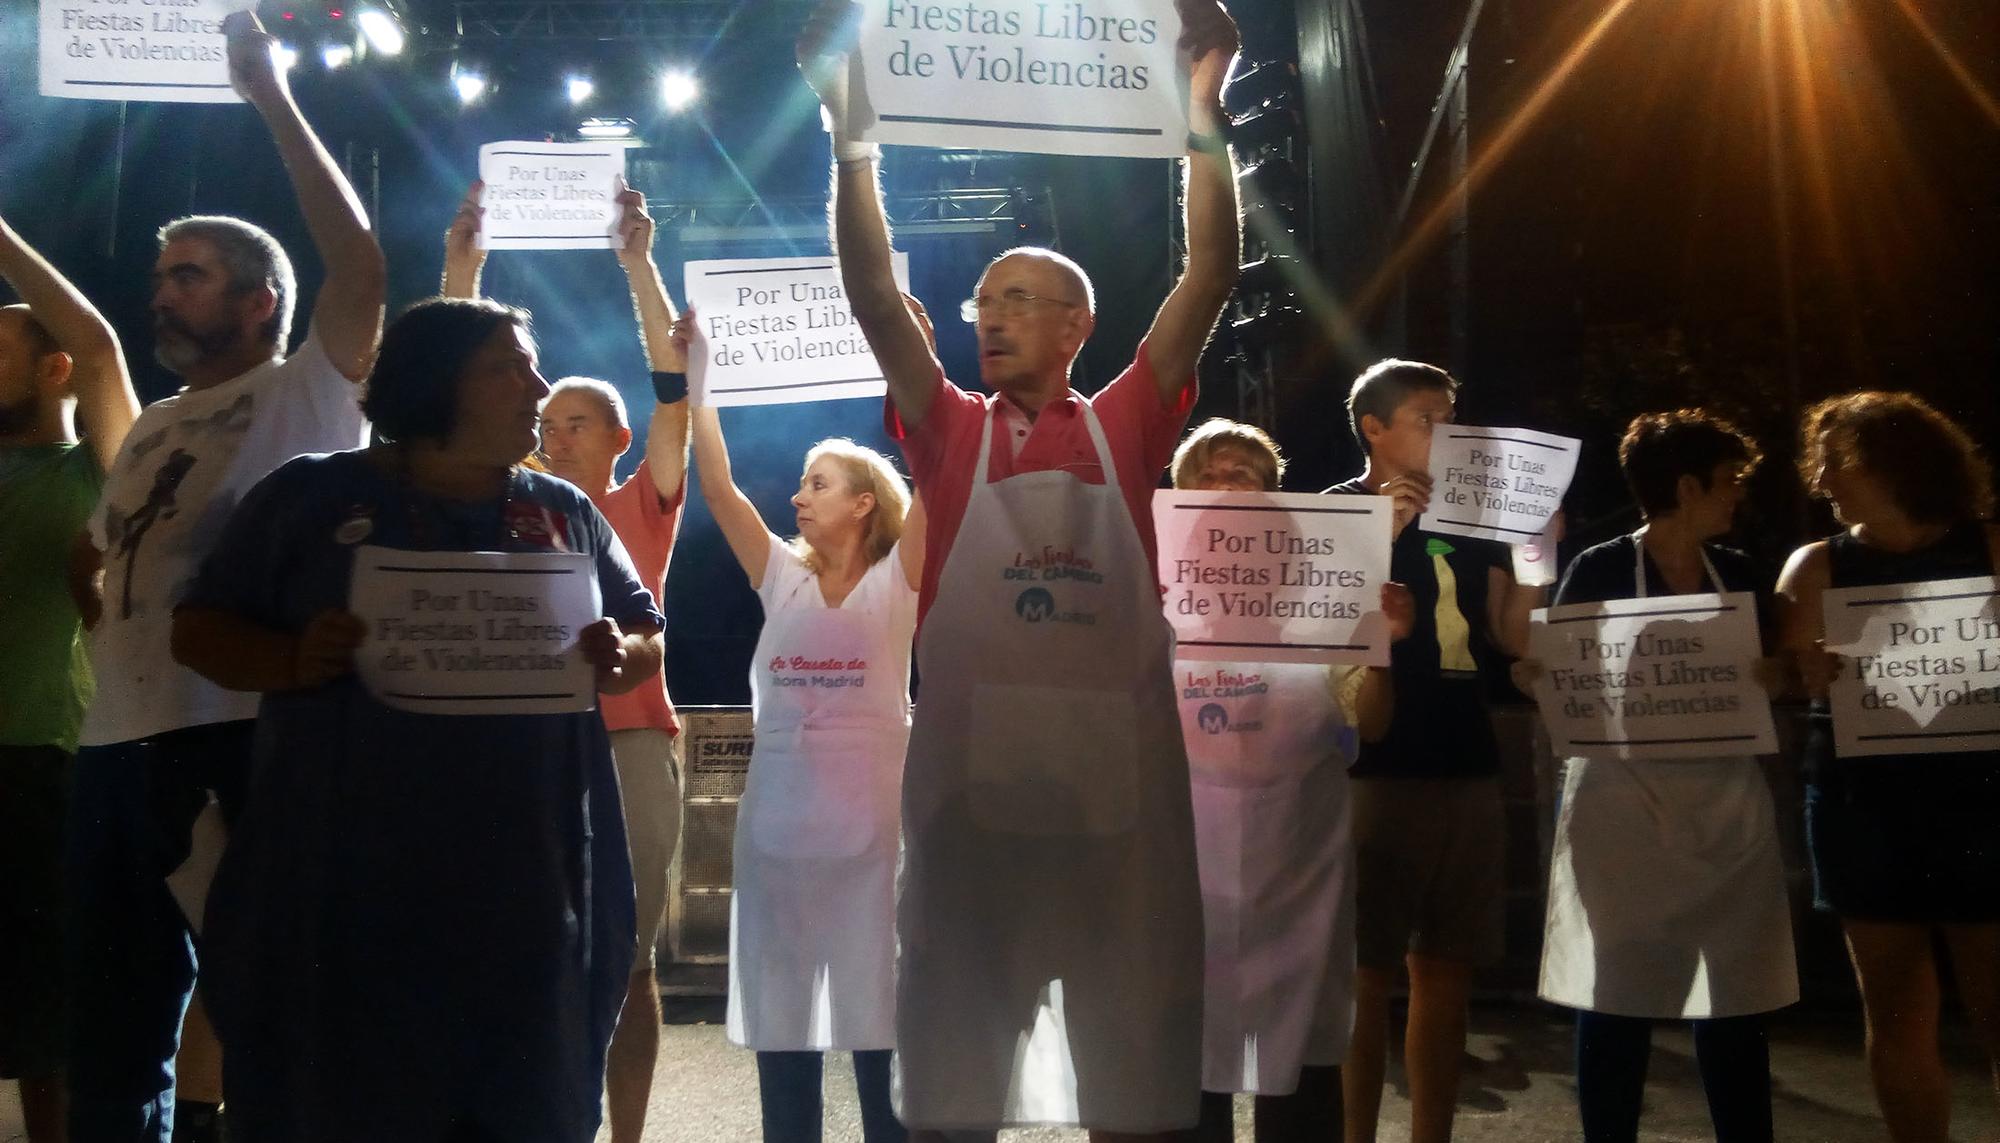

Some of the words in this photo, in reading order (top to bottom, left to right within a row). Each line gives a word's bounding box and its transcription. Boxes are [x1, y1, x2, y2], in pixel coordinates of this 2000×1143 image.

[61, 8, 144, 32] Fiestas
[883, 0, 1021, 36] Fiestas
[1035, 1, 1157, 45] Libres
[66, 35, 96, 59] de
[99, 37, 225, 62] Violencias
[889, 40, 935, 78] de
[946, 45, 1150, 91] Violencias
[508, 165, 539, 181] Por
[543, 166, 587, 181] Unas
[488, 184, 546, 200] Fiestas
[552, 184, 606, 200] Libres
[490, 203, 512, 220] de
[515, 203, 607, 220] Violencias
[736, 286, 781, 307] Por
[789, 282, 843, 302] Una
[709, 314, 798, 339] Fiestas
[806, 304, 857, 330] Libr
[714, 344, 744, 367] de
[752, 332, 873, 363] Violencia
[1469, 449, 1503, 468] Por
[1508, 453, 1547, 475] Unas
[1445, 467, 1509, 490] Fiestas
[1514, 476, 1559, 498] Libres
[1444, 487, 1467, 505] de
[1472, 490, 1551, 517] Violencias
[1207, 529, 1256, 553] Por
[1264, 530, 1335, 556] Unas
[1175, 559, 1271, 585] Fiestas
[1279, 561, 1366, 588] Libres
[411, 589, 460, 611] Por
[468, 590, 539, 612] Unas
[1177, 590, 1210, 616] de
[1217, 592, 1361, 620] Violencias
[377, 618, 478, 641] Fiestas
[485, 618, 571, 641] Libres
[1889, 622, 1945, 647] Por
[1954, 616, 2000, 642] Un
[380, 647, 417, 671] de
[423, 648, 567, 672] Violencias
[1578, 638, 1626, 661] Por
[1633, 633, 1705, 657] Unas
[847, 657, 866, 671] de
[1551, 667, 1646, 691] Fiestas
[1653, 660, 1738, 687] Libres
[1855, 654, 1966, 680] Fiestas
[811, 675, 865, 688] Madrid
[1184, 687, 1211, 699] DEL
[1861, 685, 1899, 710] de
[1907, 680, 2000, 708] Viole
[1564, 695, 1595, 719] de
[1600, 690, 1740, 718] Violencias
